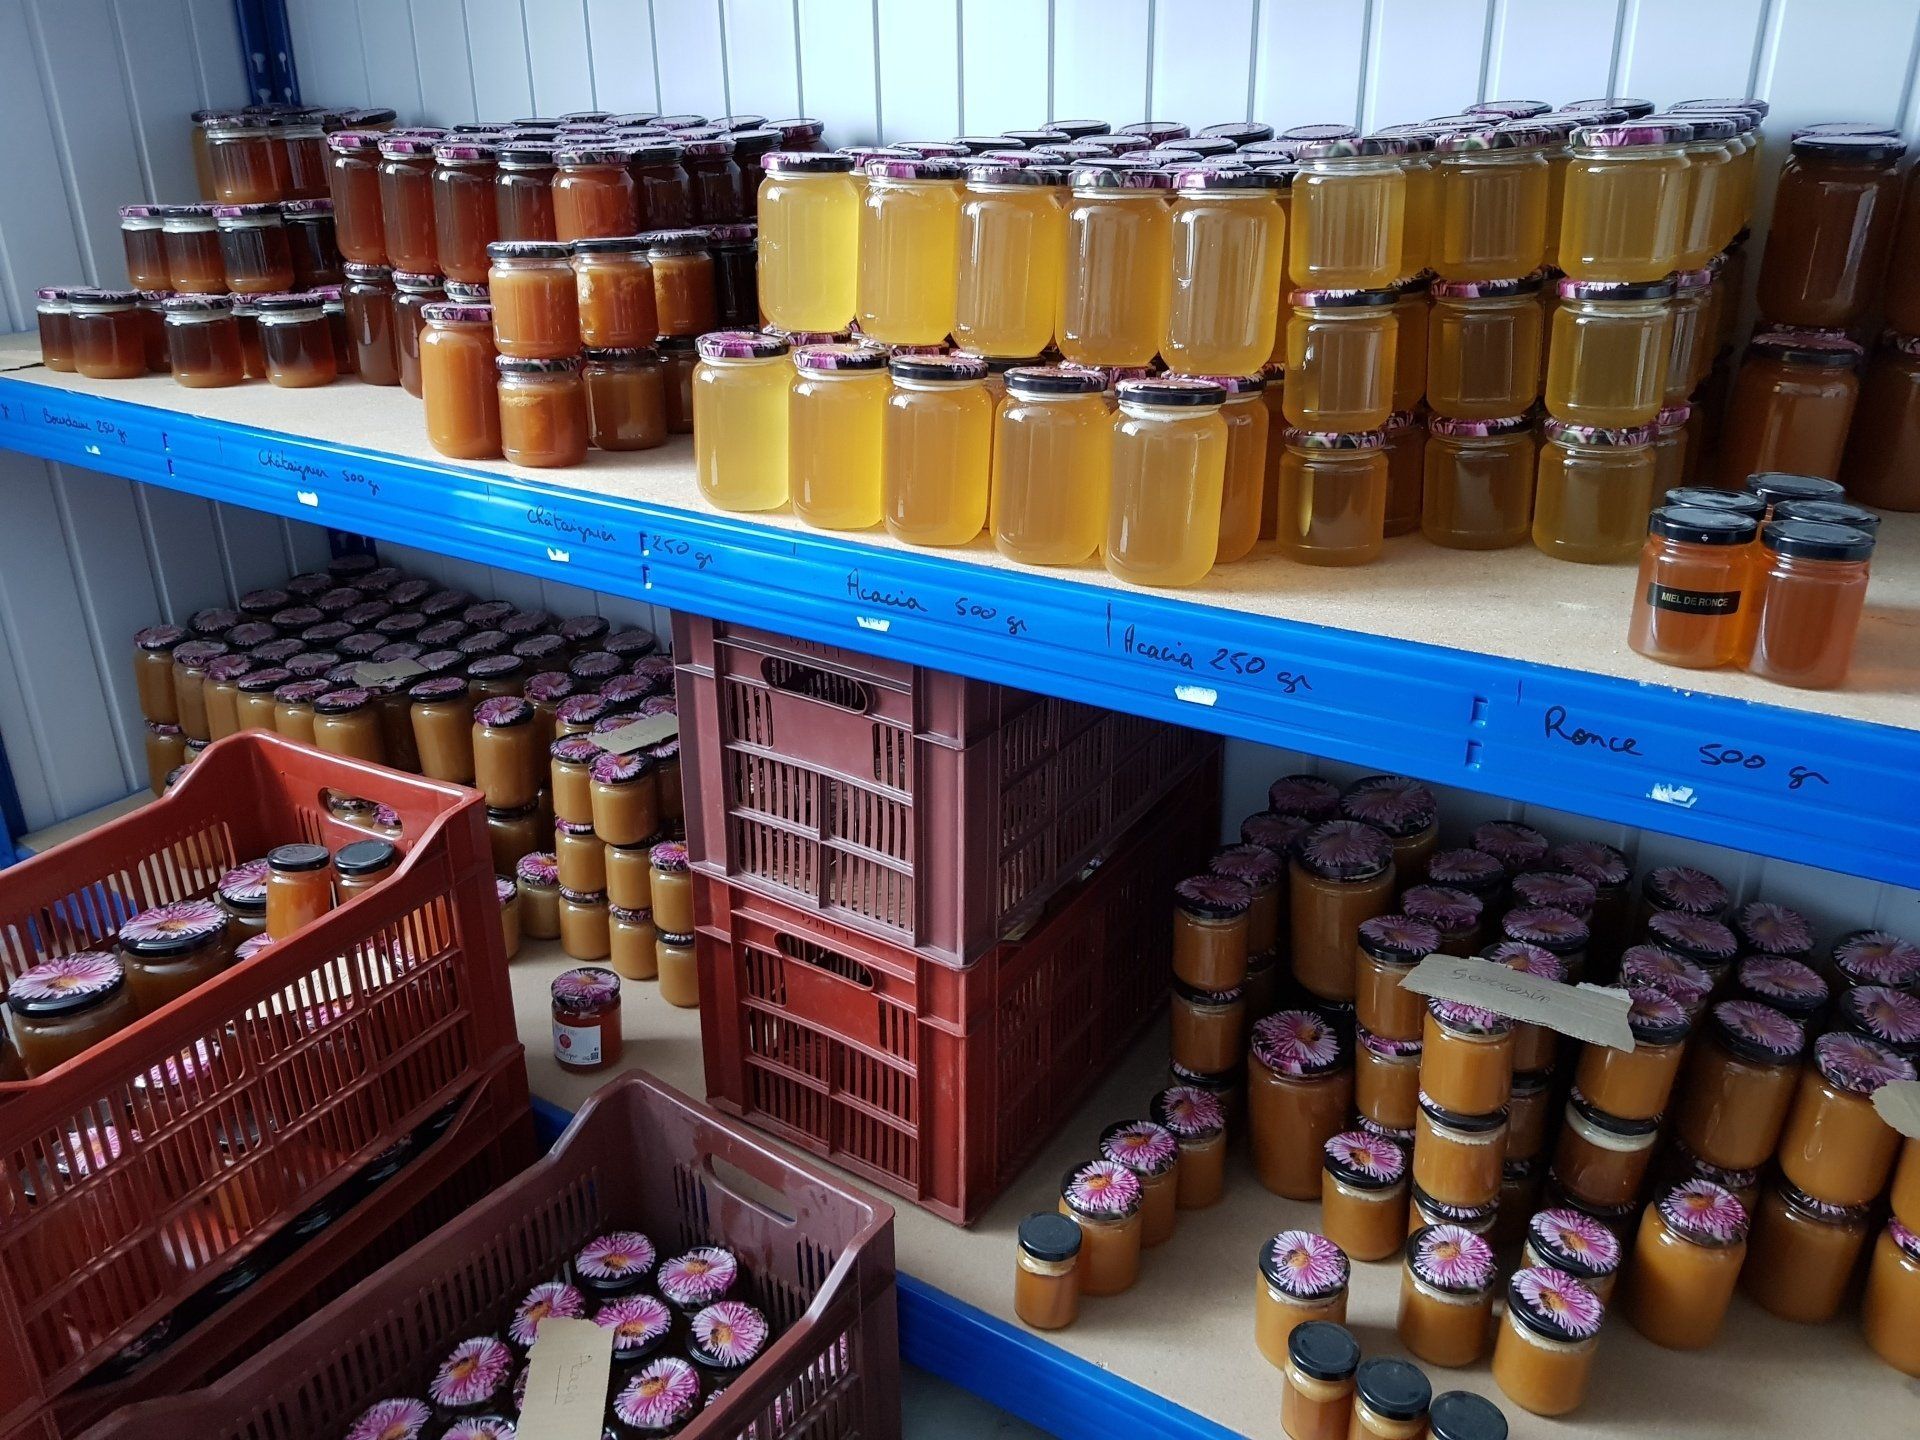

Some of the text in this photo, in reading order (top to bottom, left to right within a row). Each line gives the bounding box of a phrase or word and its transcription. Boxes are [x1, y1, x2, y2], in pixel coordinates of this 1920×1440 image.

[342, 470, 365, 483] 500
[368, 480, 380, 496] gr
[652, 535, 690, 555] 250
[695, 551, 714, 569] gr
[847, 567, 1028, 635] Acacia 500 gr
[1661, 591, 1729, 607] MIEL DE RONCE
[1124, 623, 1313, 694] Acacia 250 gr
[1544, 705, 1830, 790] Ronce 500 gr
